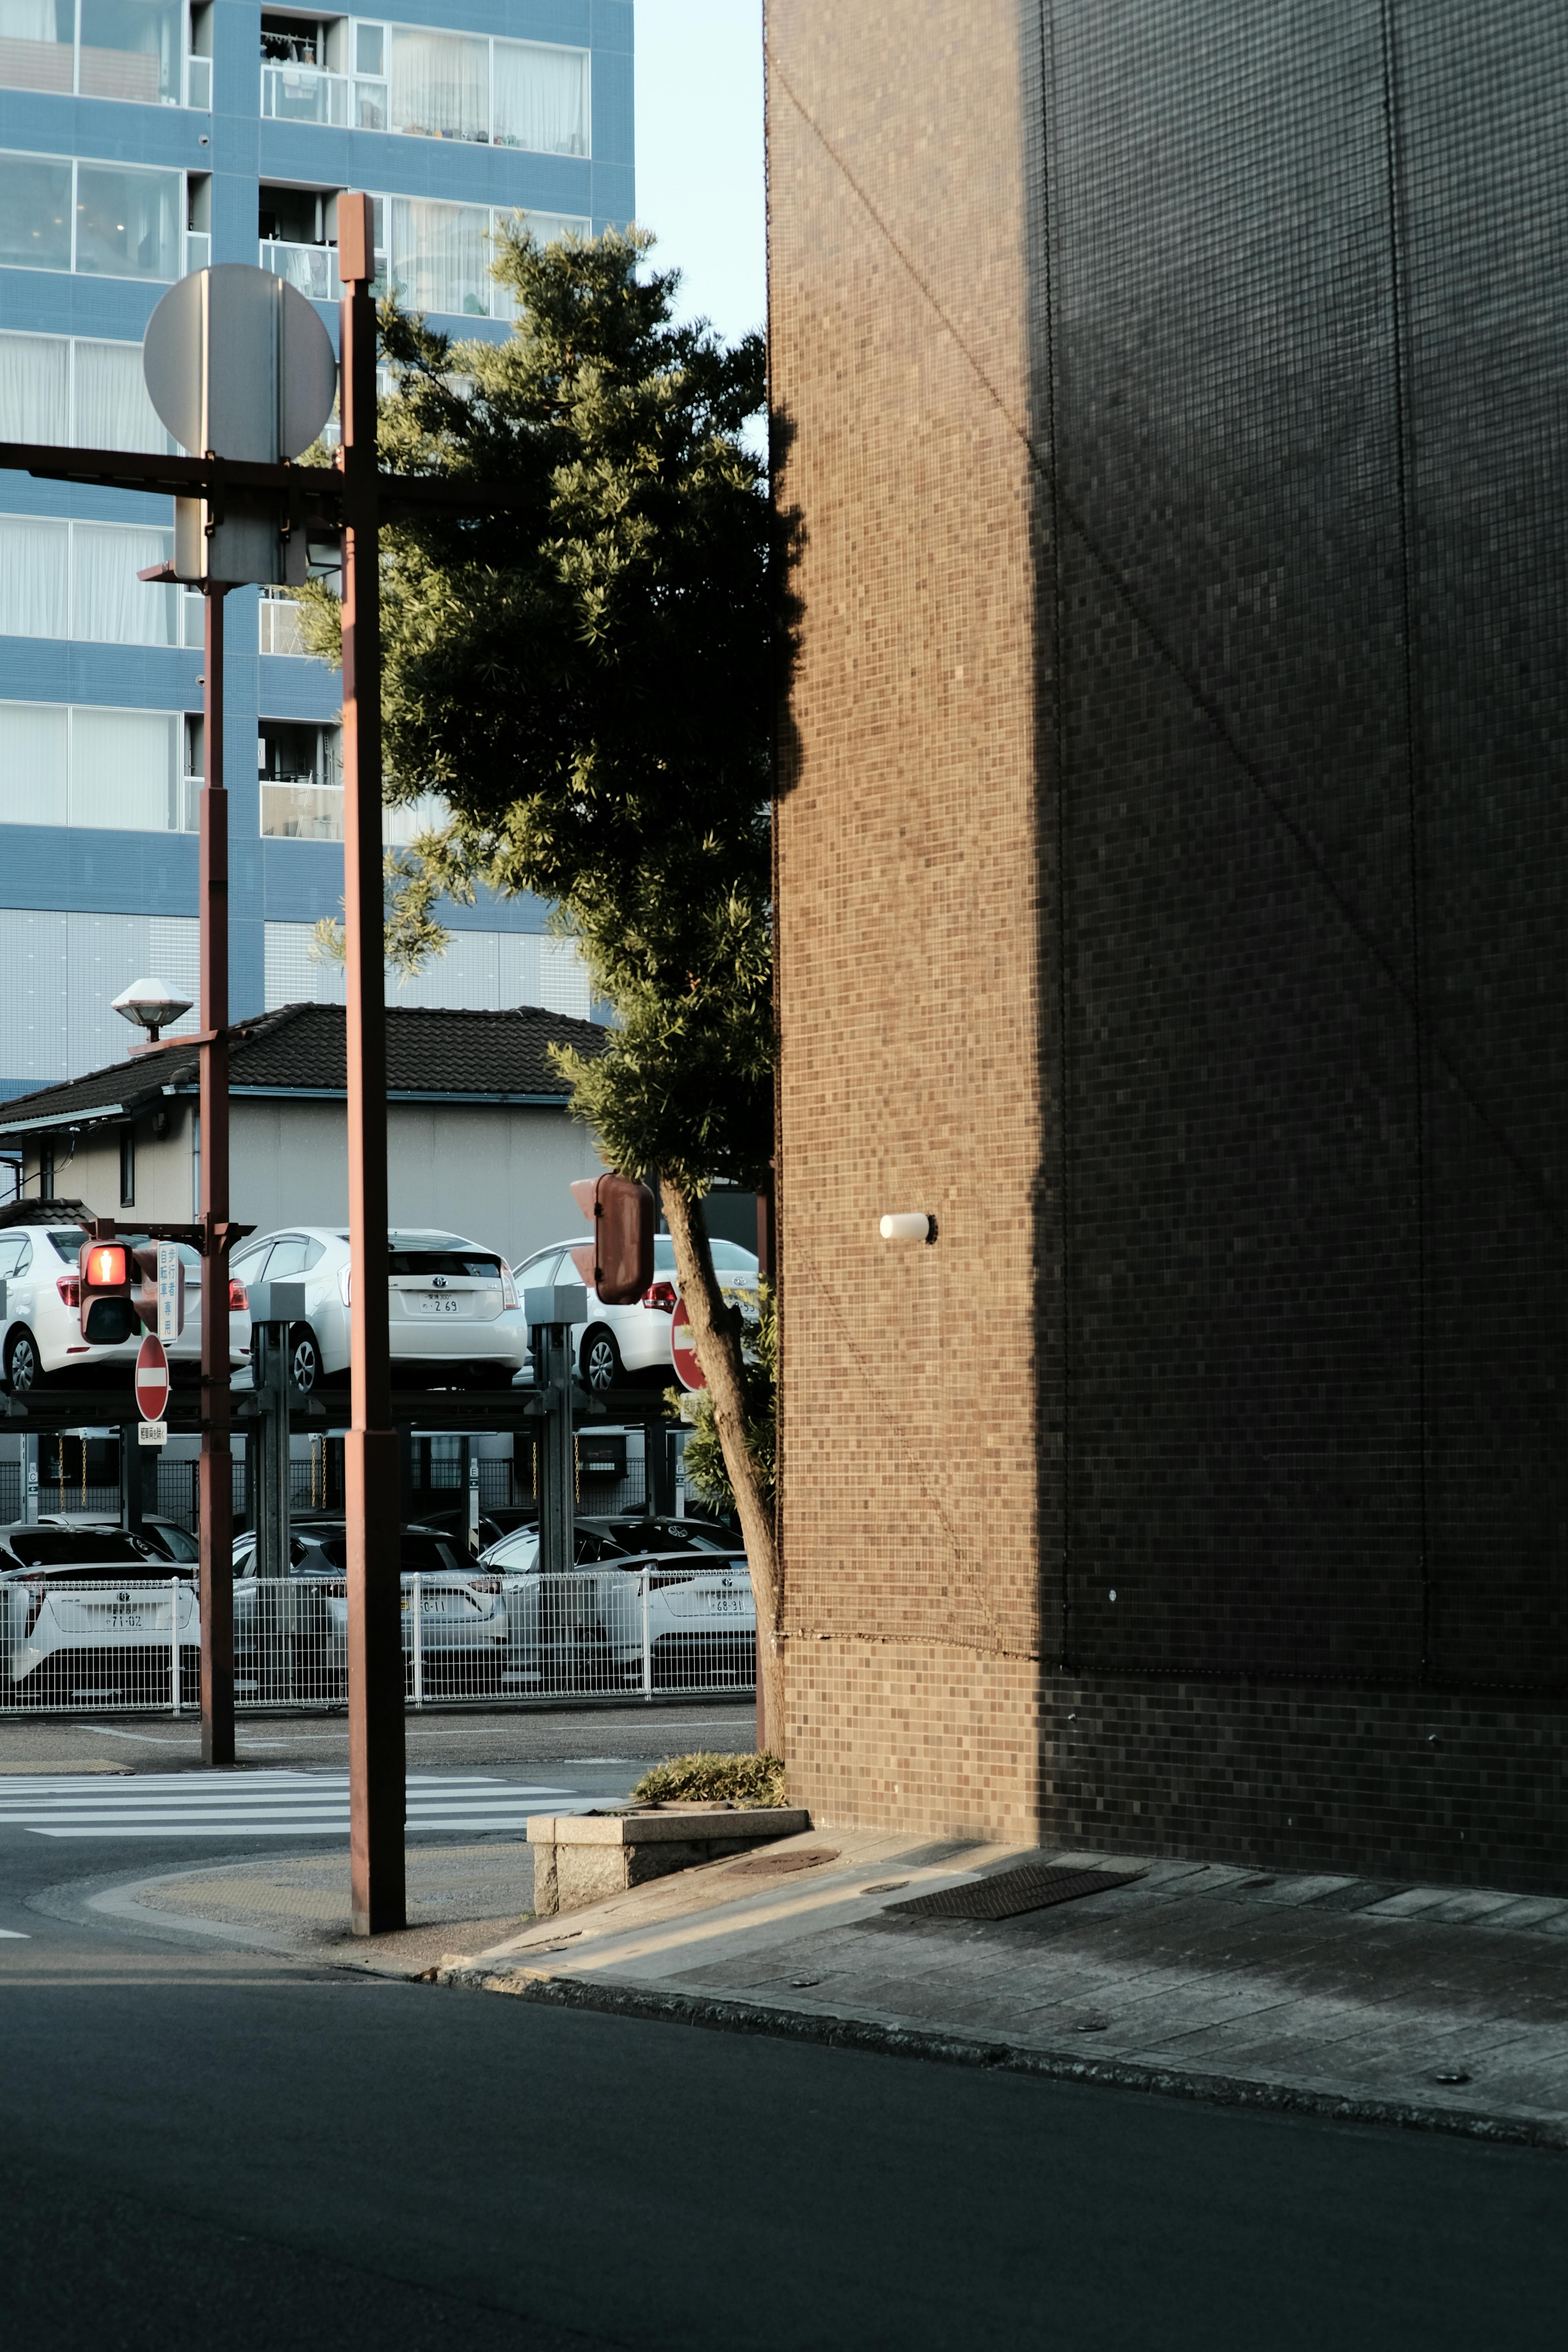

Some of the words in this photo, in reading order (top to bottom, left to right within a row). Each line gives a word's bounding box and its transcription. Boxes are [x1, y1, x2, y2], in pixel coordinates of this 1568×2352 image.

[164, 1300, 171, 1335] 専用
[141, 1427, 164, 1439] 軽車両を除く
[717, 1601, 742, 1611] 68-91
[111, 1616, 142, 1627] 71-02
